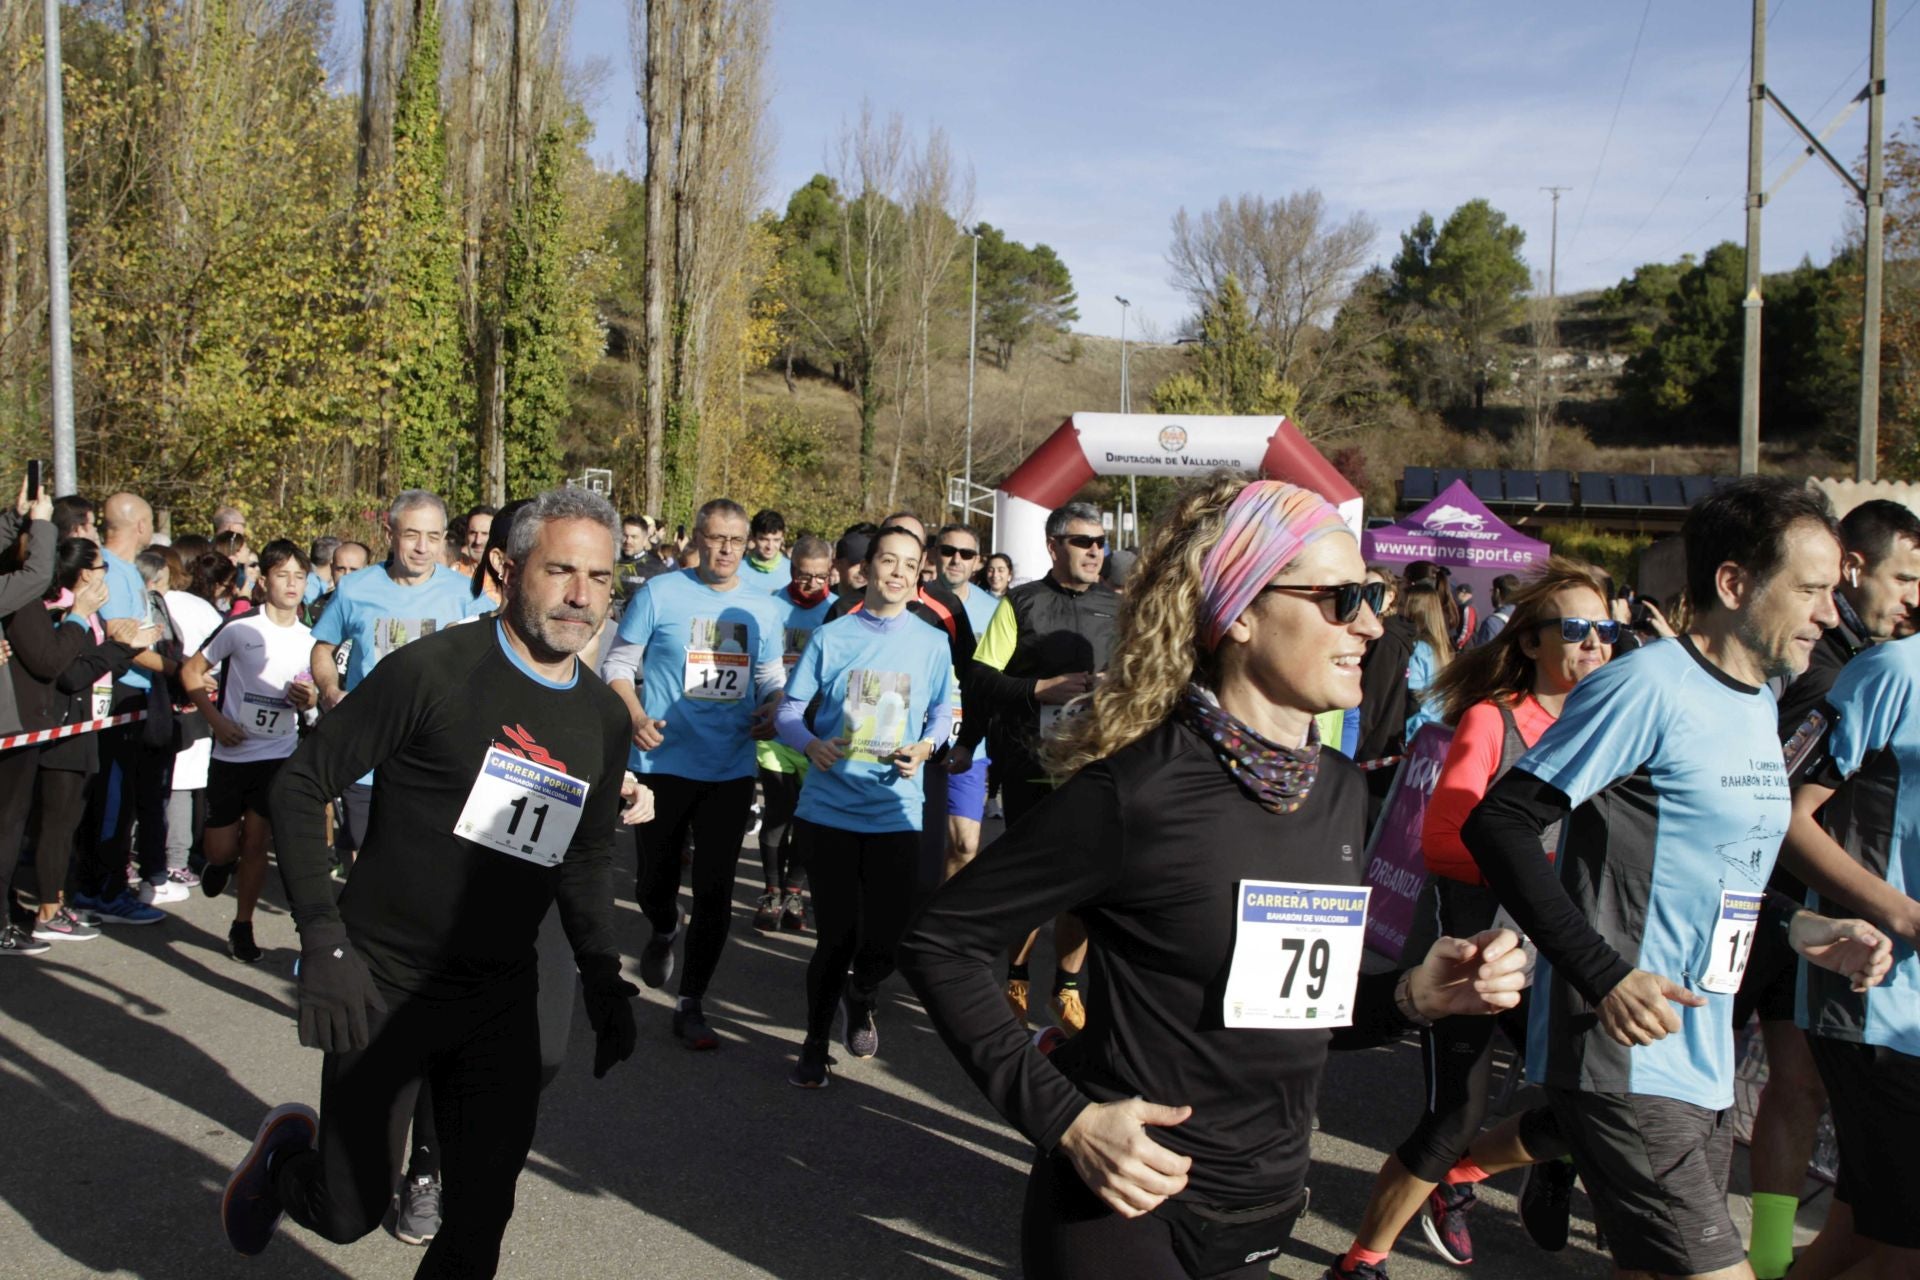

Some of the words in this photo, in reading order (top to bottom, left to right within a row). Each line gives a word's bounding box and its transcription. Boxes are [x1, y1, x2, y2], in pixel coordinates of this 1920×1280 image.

[1181, 456, 1241, 467] VALLADOLID
[1374, 542, 1533, 563] www.runvasport.es
[700, 669, 737, 690] 172
[255, 708, 280, 728] 57
[491, 756, 541, 781] CARRERA
[543, 775, 583, 798] POPULAR
[1762, 776, 1772, 787] DE
[507, 796, 549, 843] 11
[1247, 892, 1309, 909] CARRERA
[1312, 896, 1365, 912] POPULAR
[1303, 913, 1314, 922] DE
[1279, 937, 1331, 1000] 79
